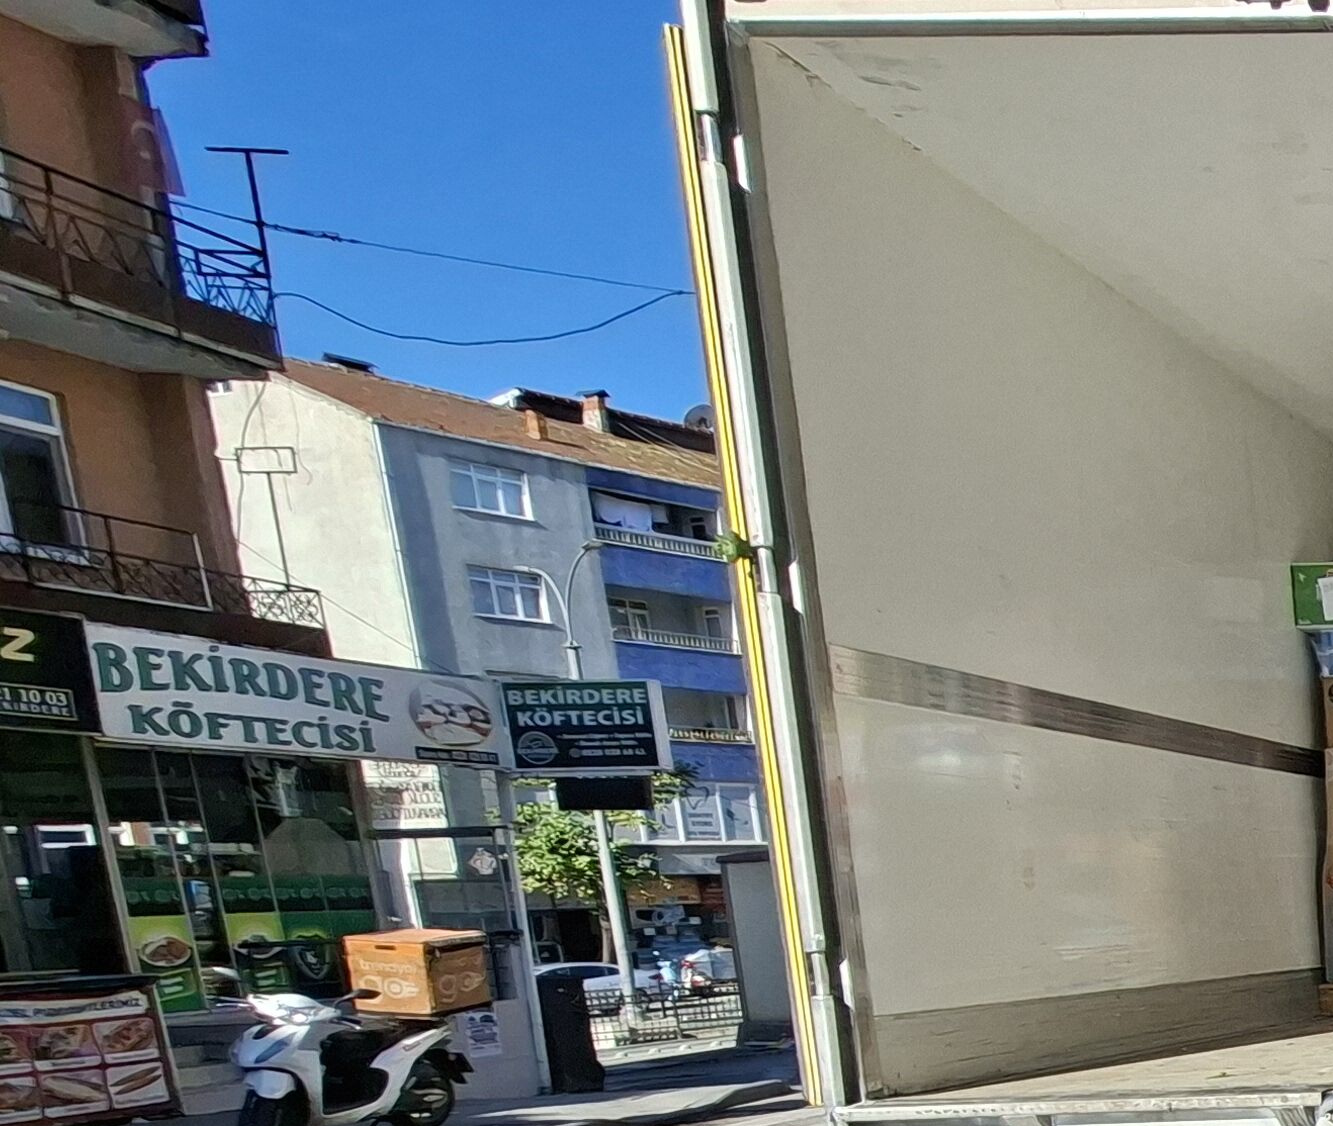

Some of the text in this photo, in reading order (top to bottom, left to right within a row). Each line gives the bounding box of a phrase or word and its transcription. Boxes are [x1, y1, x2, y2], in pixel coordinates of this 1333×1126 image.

[92, 642, 391, 723] BEKİRDERE
[45, 691, 68, 707] 03
[505, 685, 647, 706] BEKİRDERE
[126, 701, 377, 753] KÖFTECİSİ
[516, 707, 645, 727] KÖFTECİSİ
